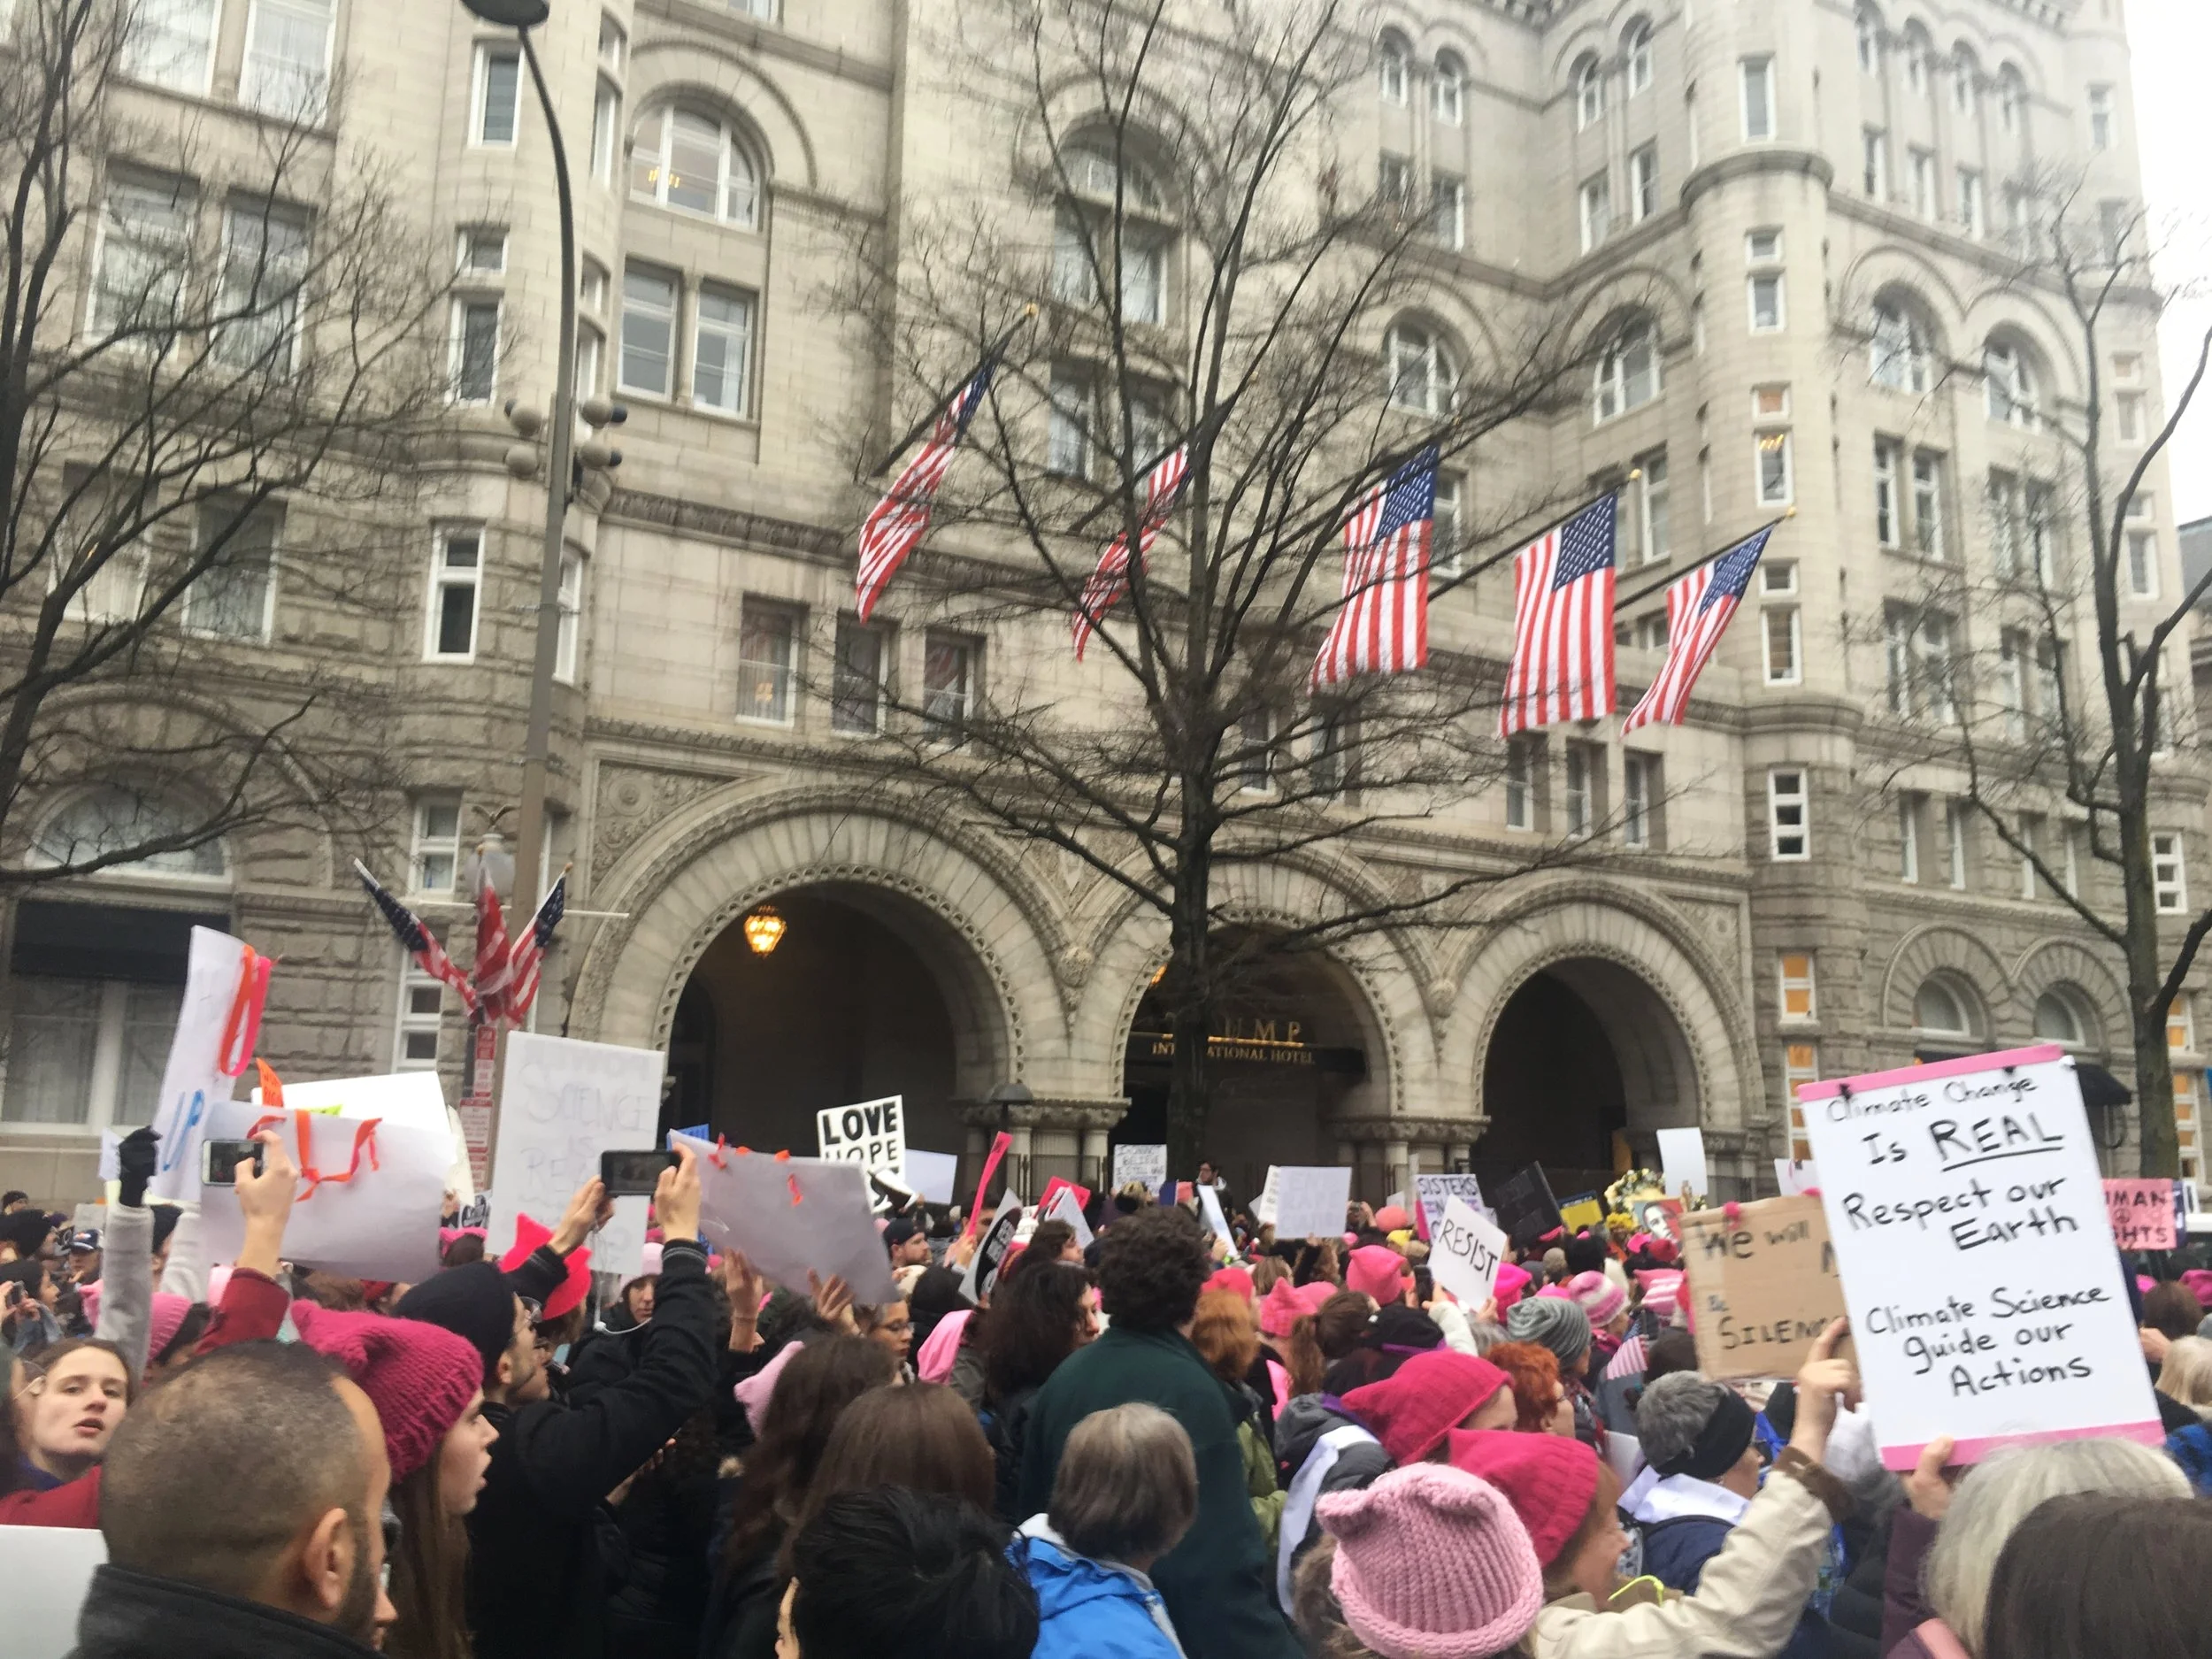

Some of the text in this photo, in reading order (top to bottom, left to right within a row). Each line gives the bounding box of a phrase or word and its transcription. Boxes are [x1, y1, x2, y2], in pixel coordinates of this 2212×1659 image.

[1271, 1048, 1315, 1065] HOTEL
[1826, 1075, 2039, 1123] Climate Change
[822, 1101, 897, 1145] LOVE
[1861, 1110, 2064, 1165] Is REAL
[1418, 1177, 1478, 1195] SISTERS
[1841, 1175, 2067, 1232] Respect our
[1439, 1218, 1498, 1282] RESIST
[1697, 1224, 1755, 1260] We
[1949, 1208, 2080, 1251] Earth
[1866, 1286, 2112, 1336] Climate Science
[1902, 1322, 2073, 1376] guide our
[1949, 1356, 2093, 1397] Actions
